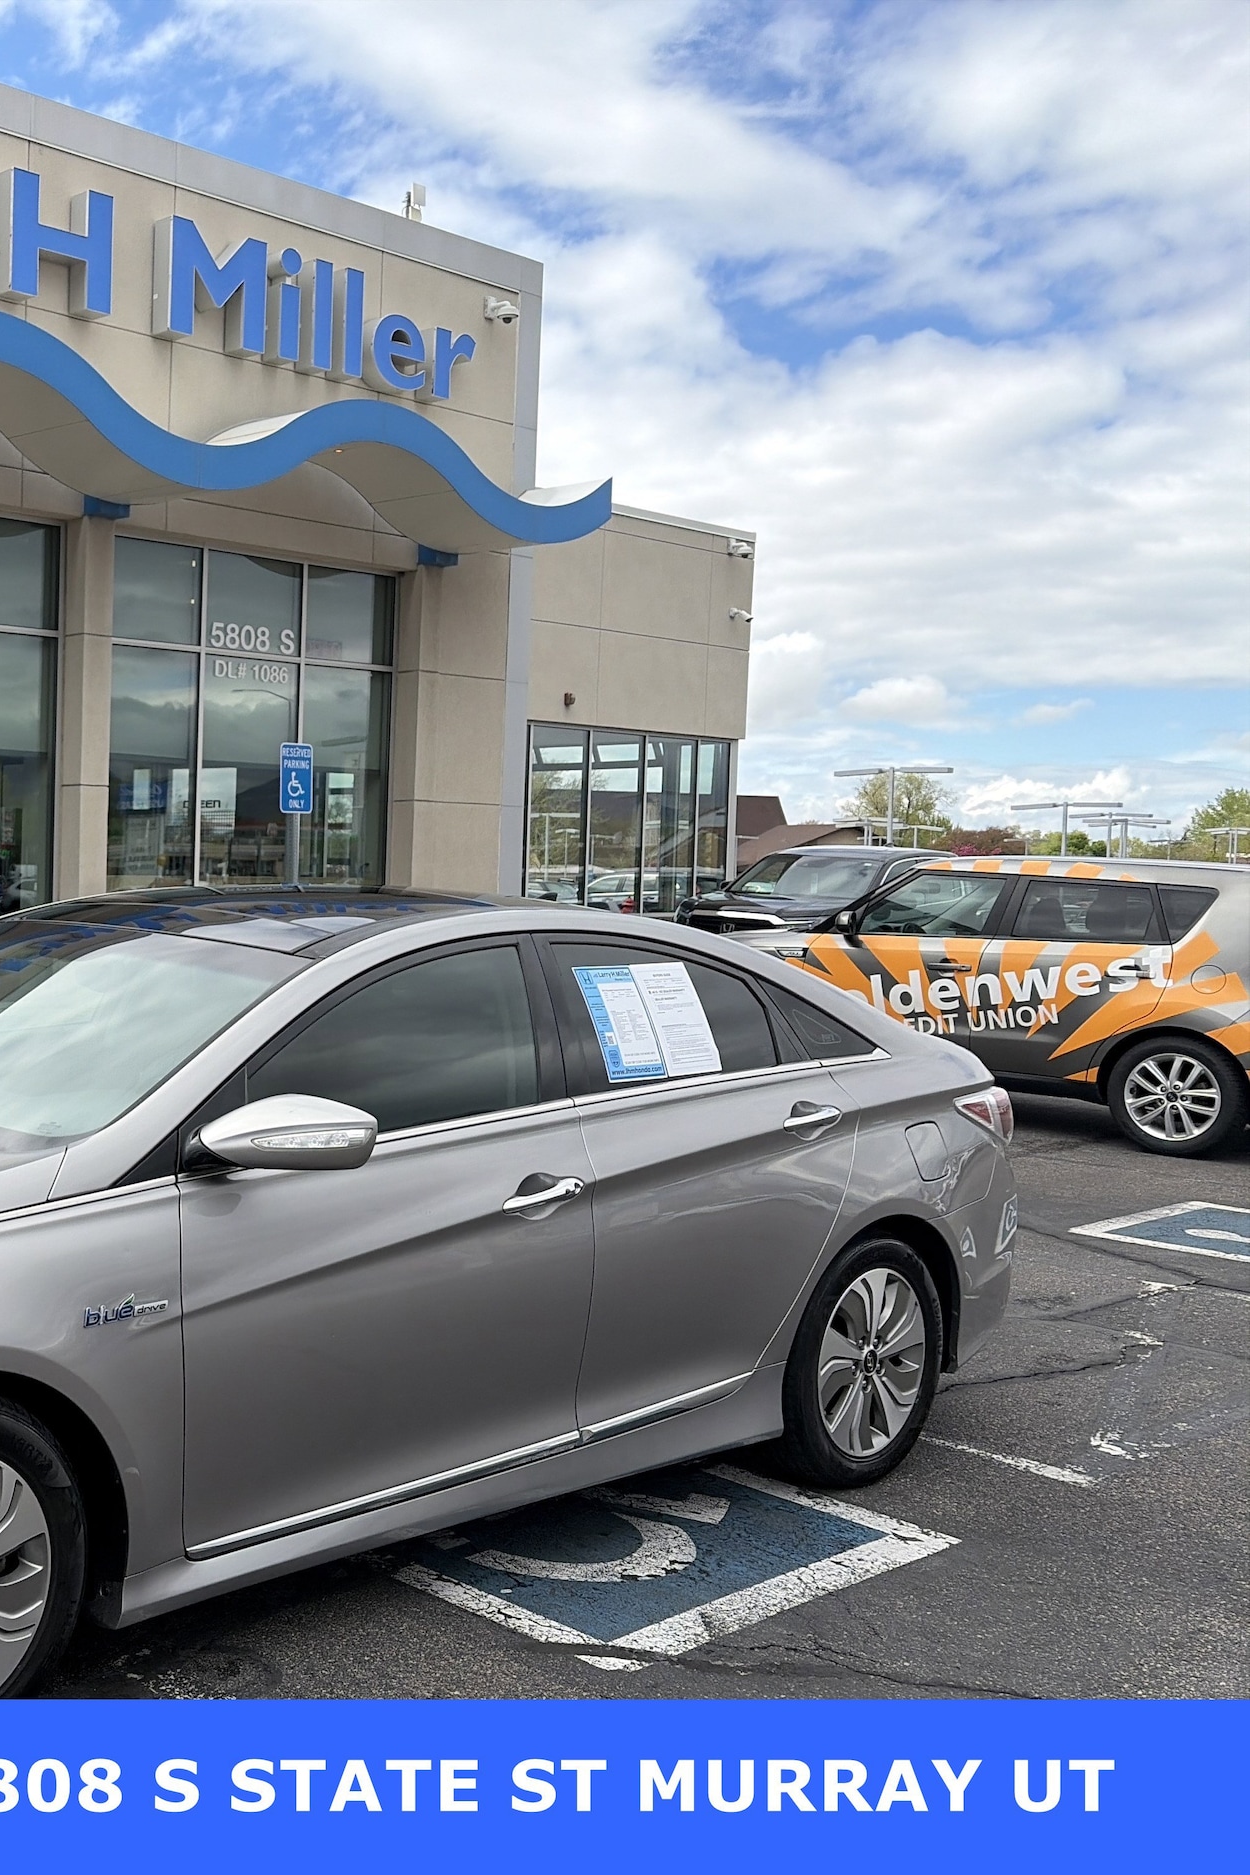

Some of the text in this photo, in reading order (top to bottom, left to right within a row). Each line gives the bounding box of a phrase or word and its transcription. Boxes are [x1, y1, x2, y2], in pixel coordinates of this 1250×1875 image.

[153, 215, 477, 400] Miller
[210, 622, 270, 653] 5808
[280, 629, 295, 655] S
[214, 660, 289, 684] DL# 1086
[282, 747, 311, 758] RESERVED
[283, 759, 310, 770] PARKING
[288, 799, 305, 809] ONLY
[969, 1003, 1059, 1033] UNION
[83, 1298, 135, 1328] blue
